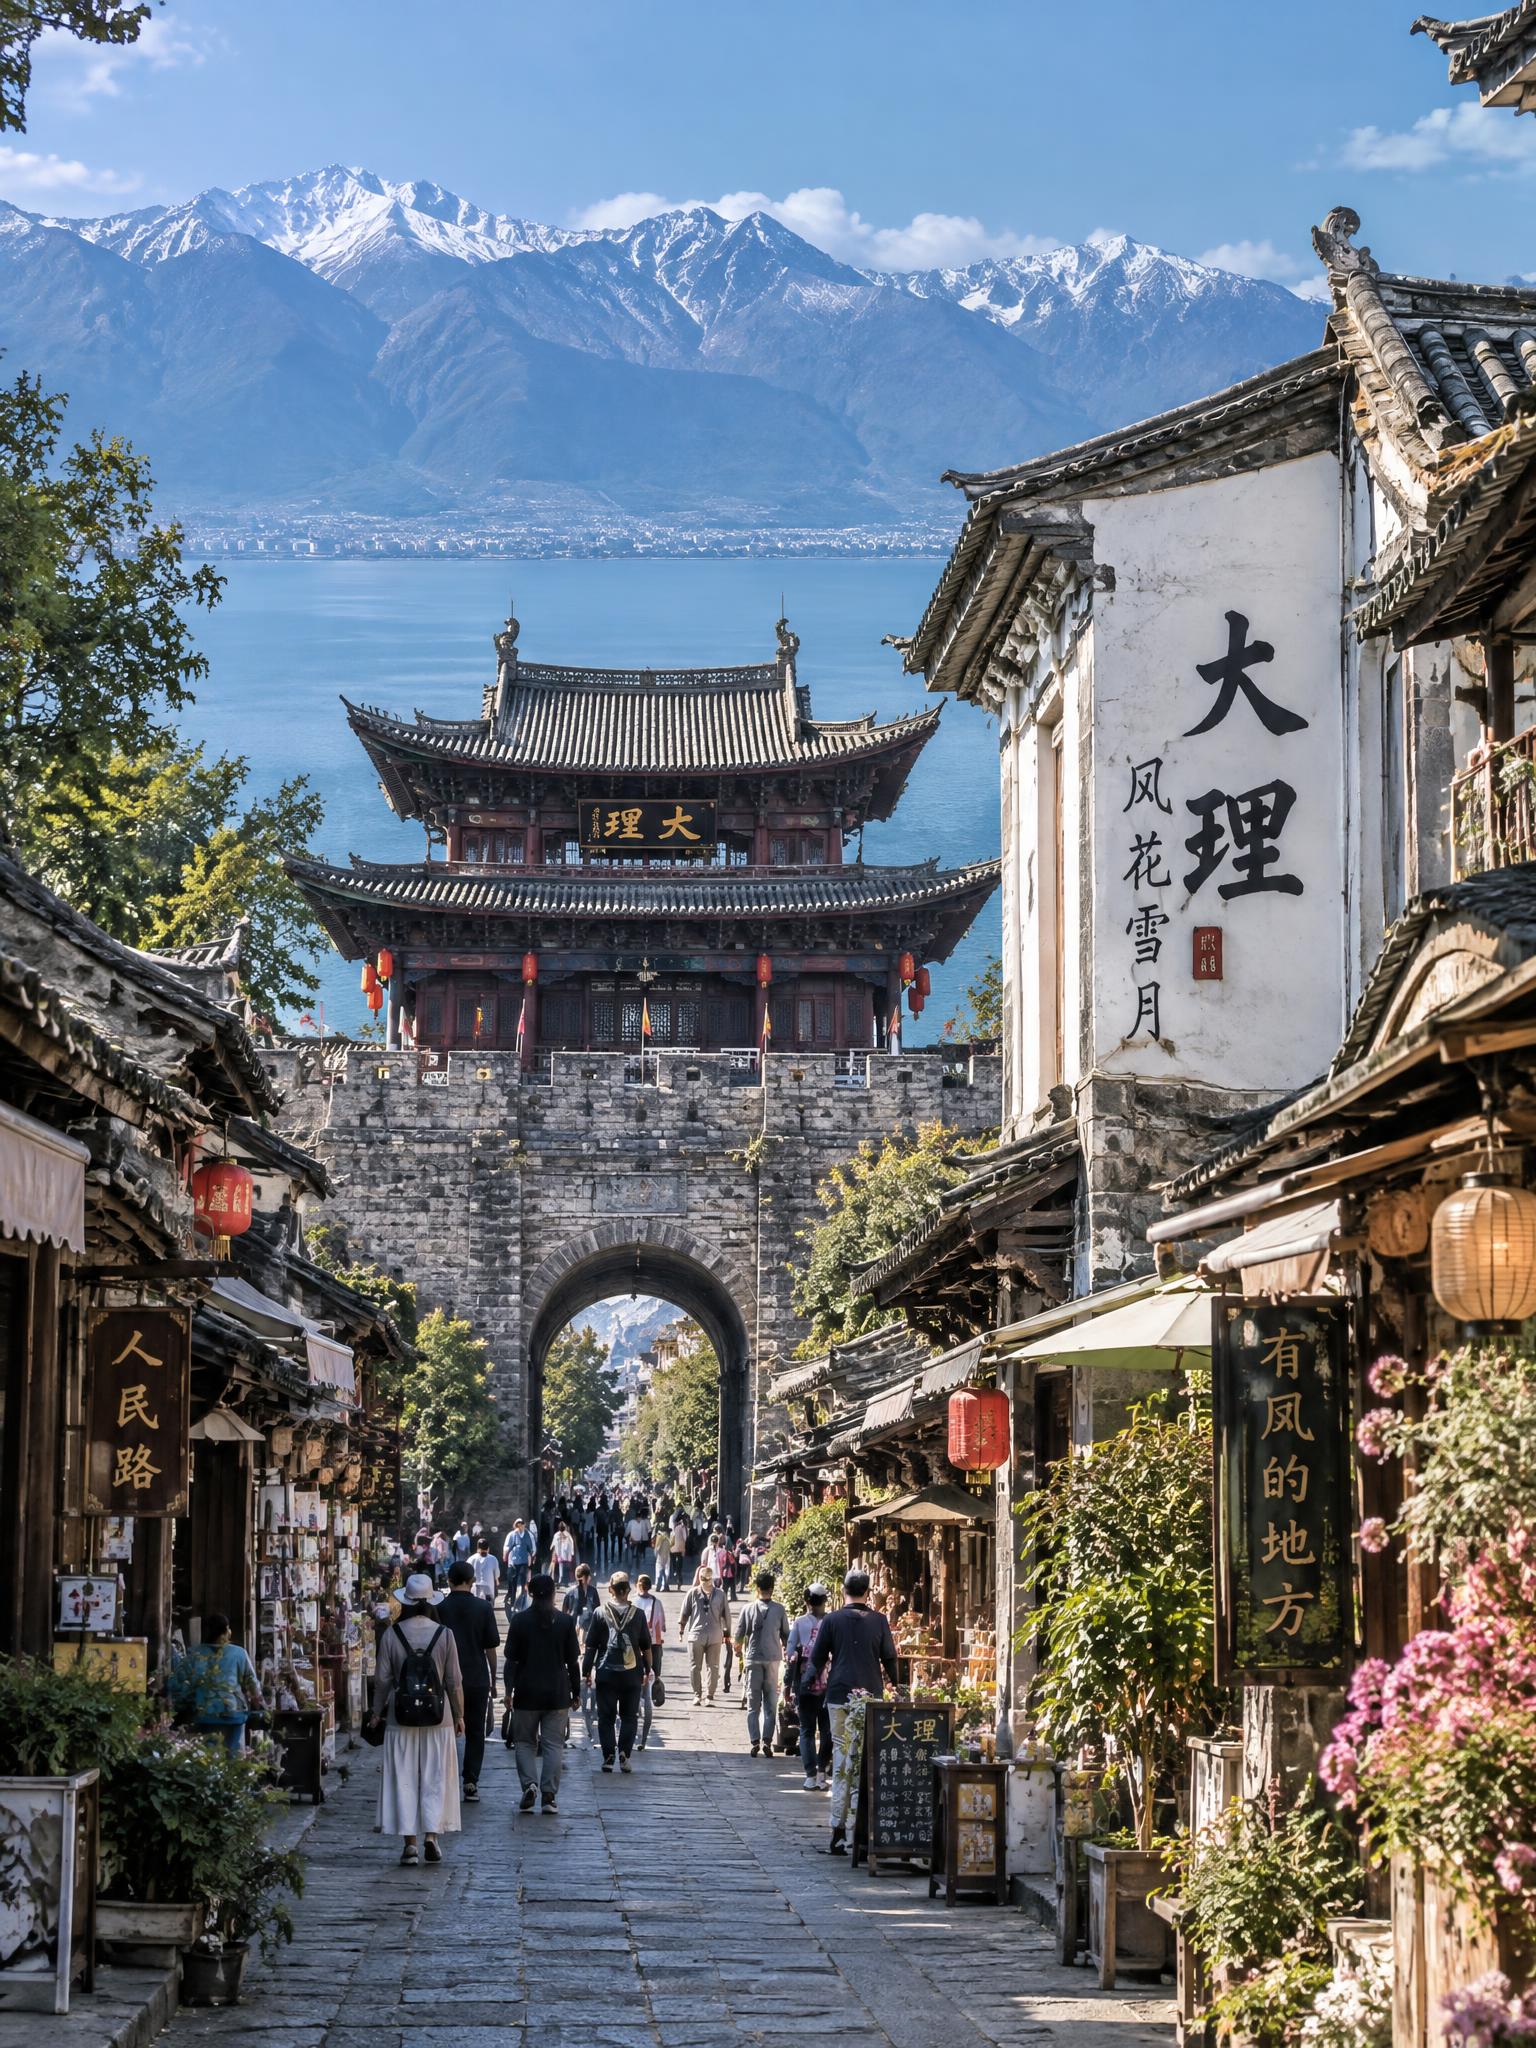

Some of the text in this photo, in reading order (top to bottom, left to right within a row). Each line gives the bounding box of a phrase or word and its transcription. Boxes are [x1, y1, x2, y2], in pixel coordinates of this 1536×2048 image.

[603, 805, 702, 840] 大理
[1182, 610, 1309, 901] 大理
[1122, 757, 1174, 1041] 风花雪月
[112, 1330, 163, 1490] 人民路
[880, 1716, 940, 1743] 大理
